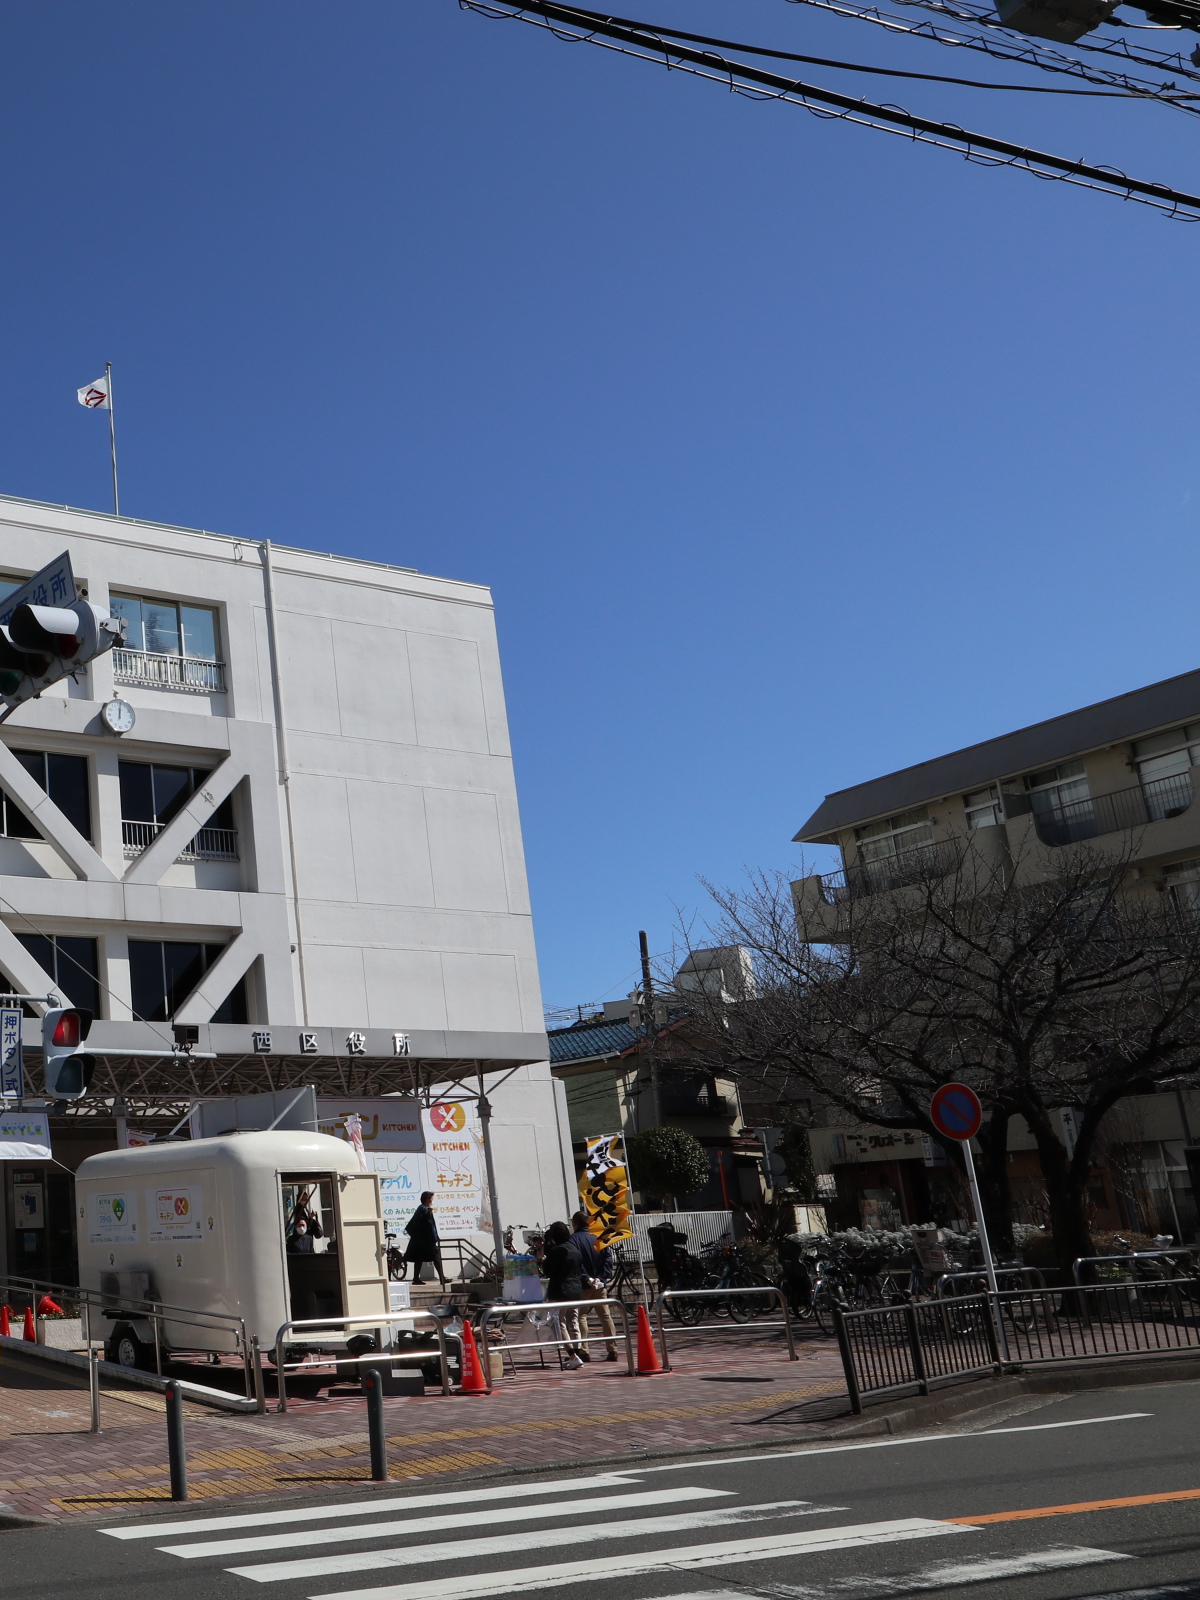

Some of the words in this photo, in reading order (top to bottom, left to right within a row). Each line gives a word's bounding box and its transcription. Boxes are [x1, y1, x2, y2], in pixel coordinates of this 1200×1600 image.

[253, 1031, 412, 1055] 西区役所
[4, 1016, 19, 1091] 押ボタン式
[1, 1125, 43, 1136] STYLE
[382, 1123, 418, 1132] KITCHEN
[432, 1142, 471, 1151] KITCHEN
[373, 1156, 408, 1173] にしく
[435, 1156, 470, 1172] にしく
[437, 1173, 473, 1187] キッチン
